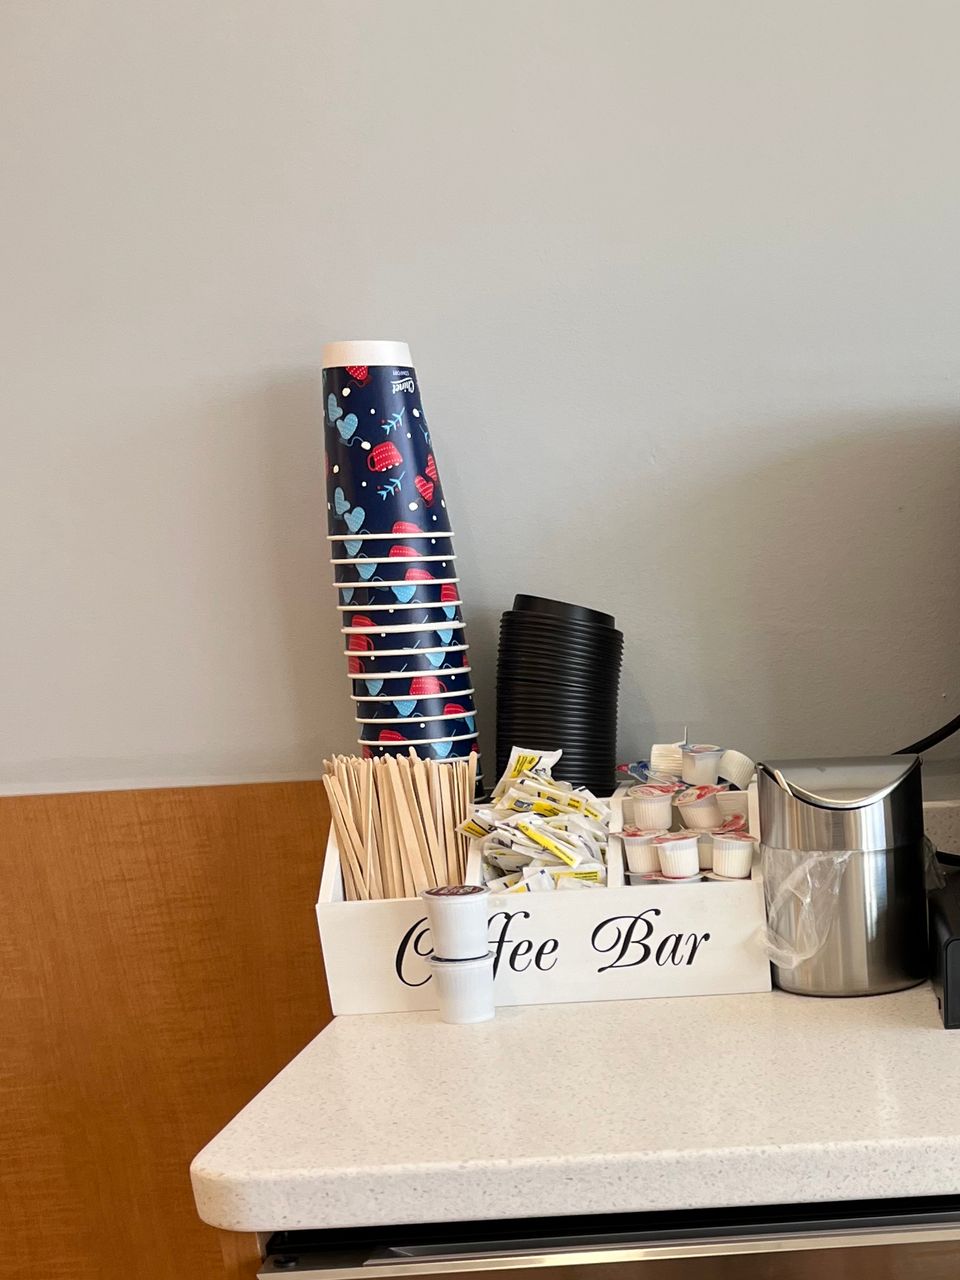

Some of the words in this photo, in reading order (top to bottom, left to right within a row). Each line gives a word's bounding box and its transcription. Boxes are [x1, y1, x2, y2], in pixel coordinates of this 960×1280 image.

[392, 380, 415, 394] Chinet
[395, 911, 559, 987] Cfee
[591, 908, 711, 973] Bar
